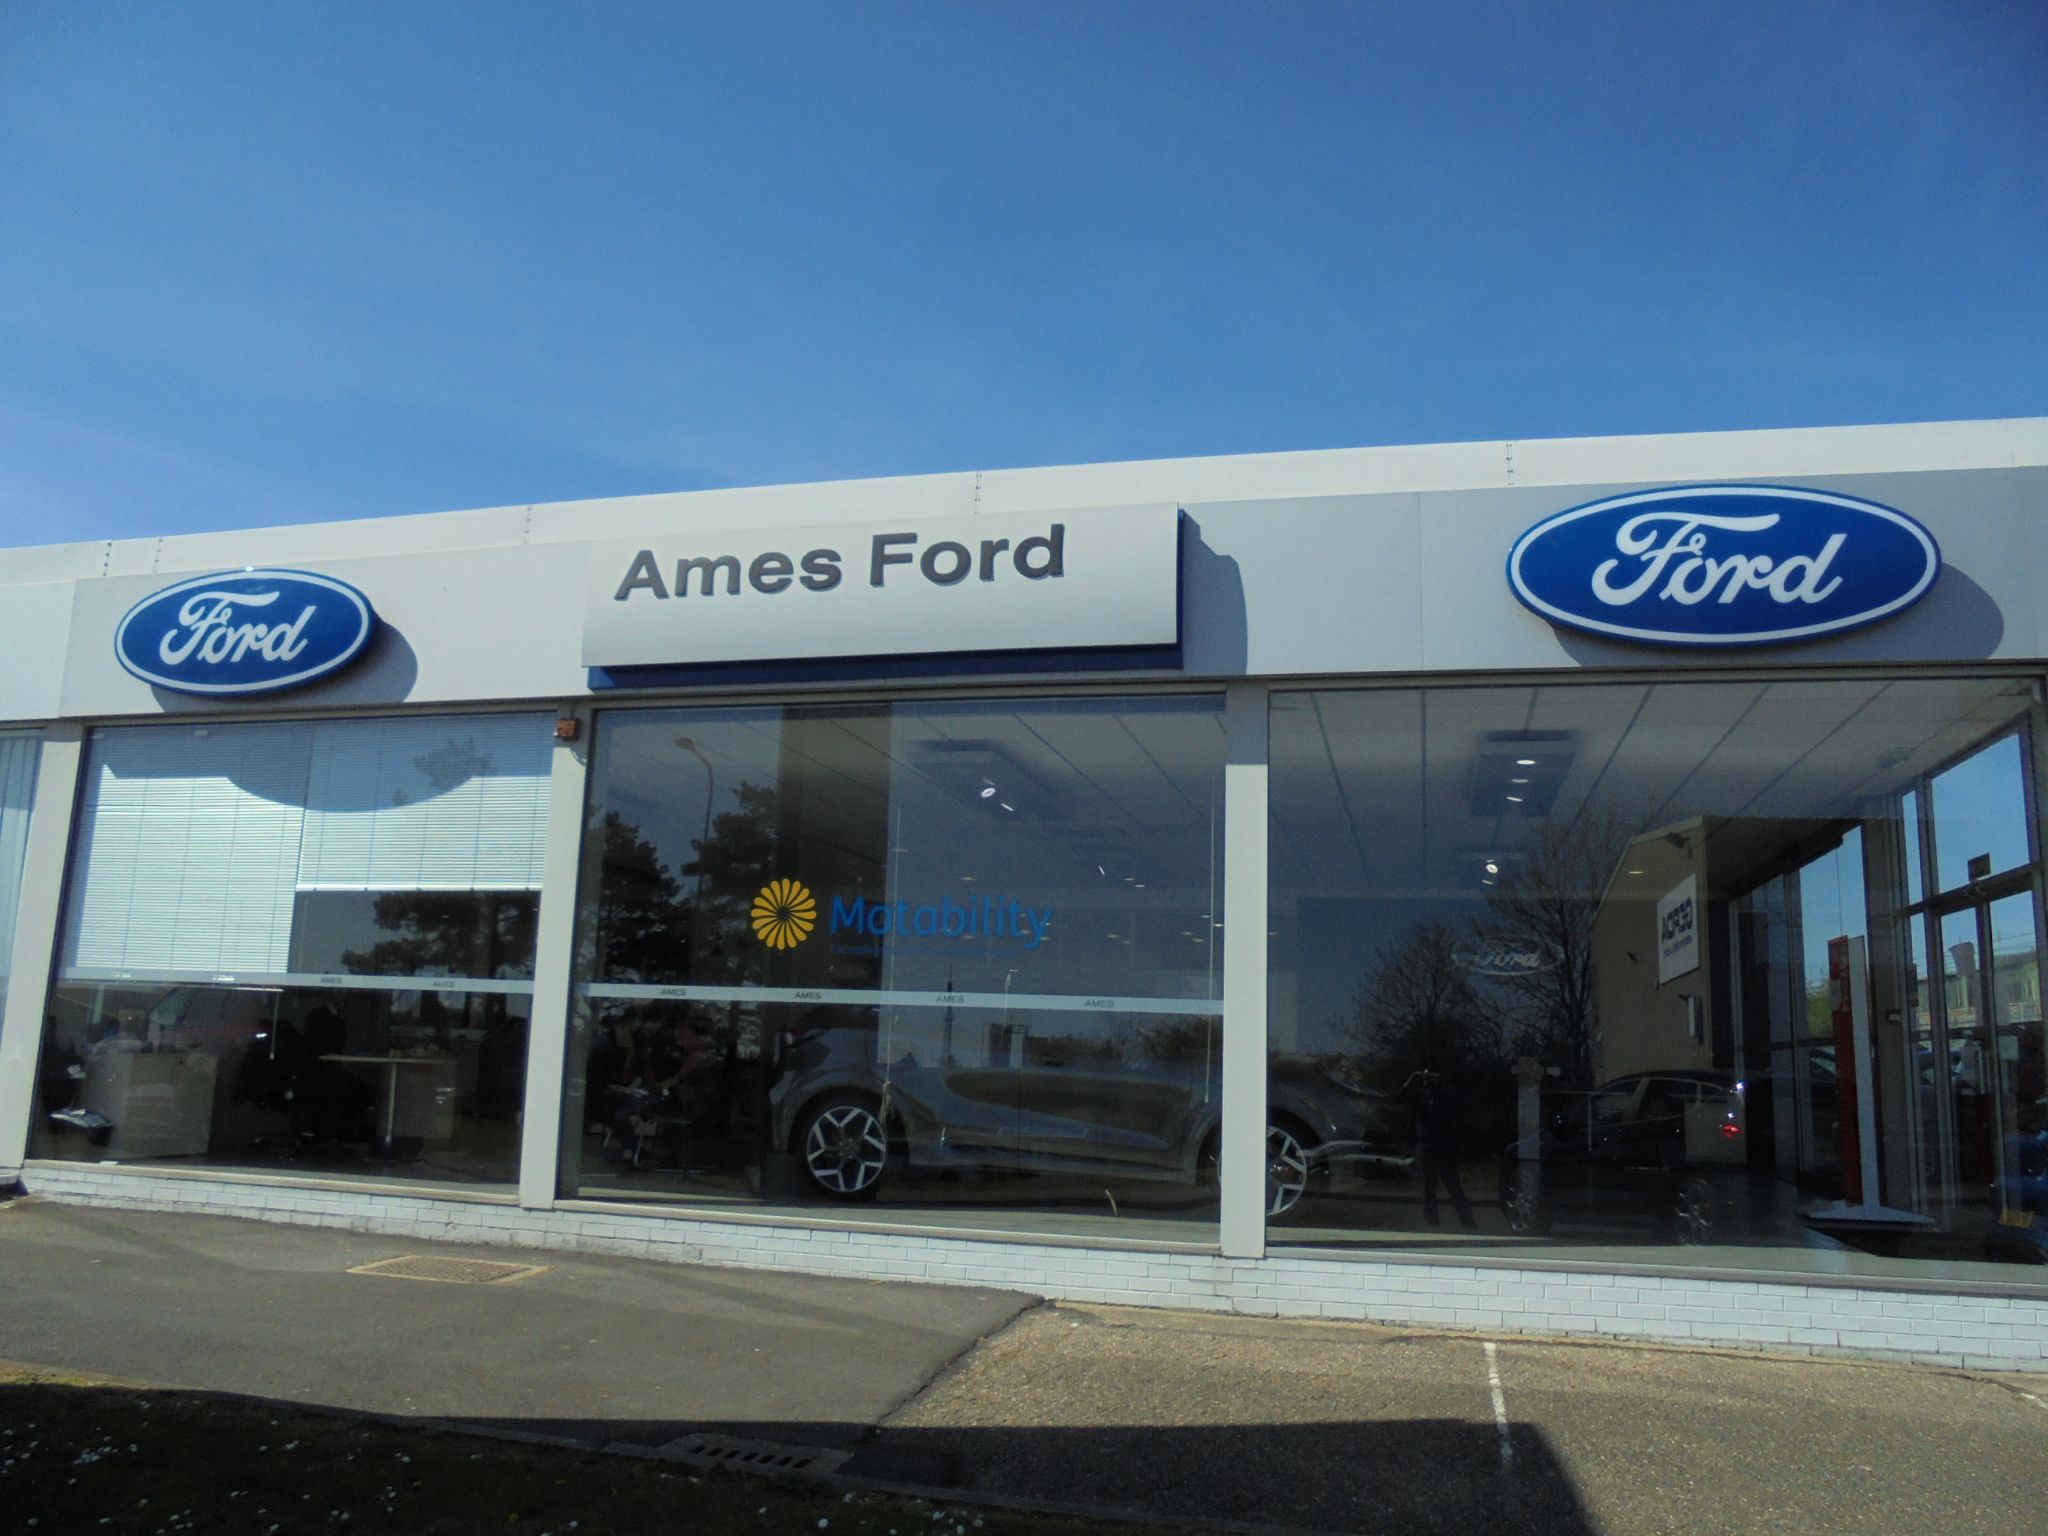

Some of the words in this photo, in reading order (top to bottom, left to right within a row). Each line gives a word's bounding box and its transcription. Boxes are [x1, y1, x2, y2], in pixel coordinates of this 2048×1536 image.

[614, 549, 843, 600] Ames
[869, 523, 1065, 588] Ford
[1591, 511, 1848, 606] Ford
[159, 591, 317, 665] Ford
[830, 895, 1055, 949] Motability
[660, 988, 687, 997] AMES
[794, 991, 822, 1000] AMES
[936, 995, 965, 1004] AMES
[1084, 999, 1115, 1009] AMES
